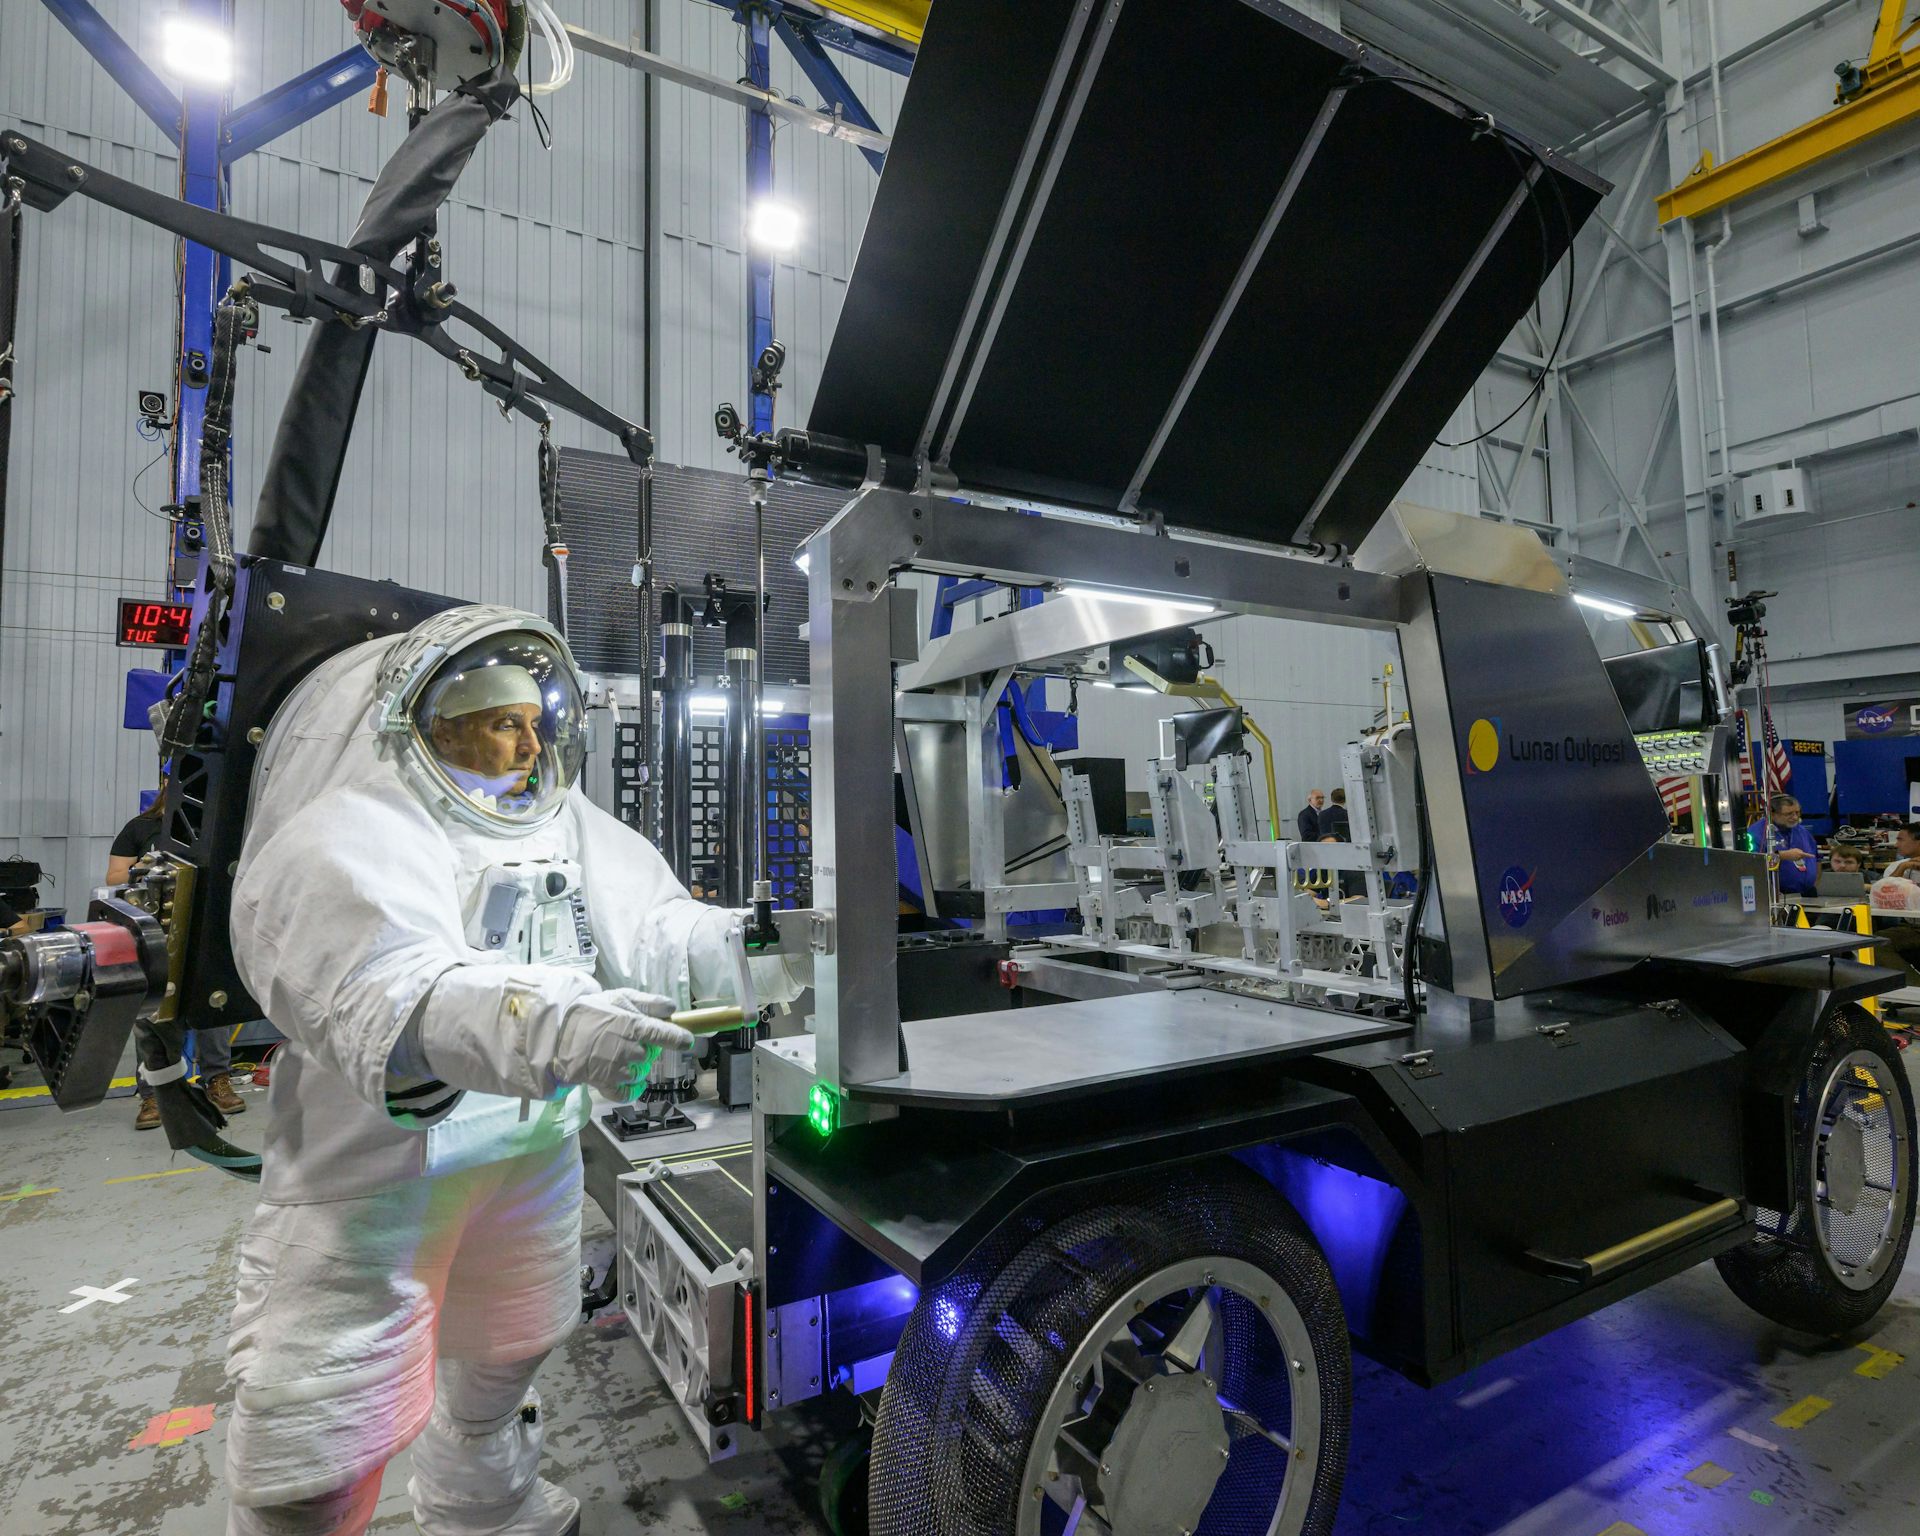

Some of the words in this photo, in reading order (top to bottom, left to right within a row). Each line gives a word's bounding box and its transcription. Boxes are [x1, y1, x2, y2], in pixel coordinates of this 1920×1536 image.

[133, 605, 193, 628] 10:4
[127, 628, 157, 643] TUE
[1858, 715, 1893, 725] NASA
[1508, 734, 1560, 762] Lunar
[1564, 736, 1625, 768] Outpost
[1793, 741, 1823, 754] RESPECT
[1500, 889, 1533, 905] NASA
[1658, 899, 1677, 913] MDA
[1602, 909, 1629, 927] leidos
